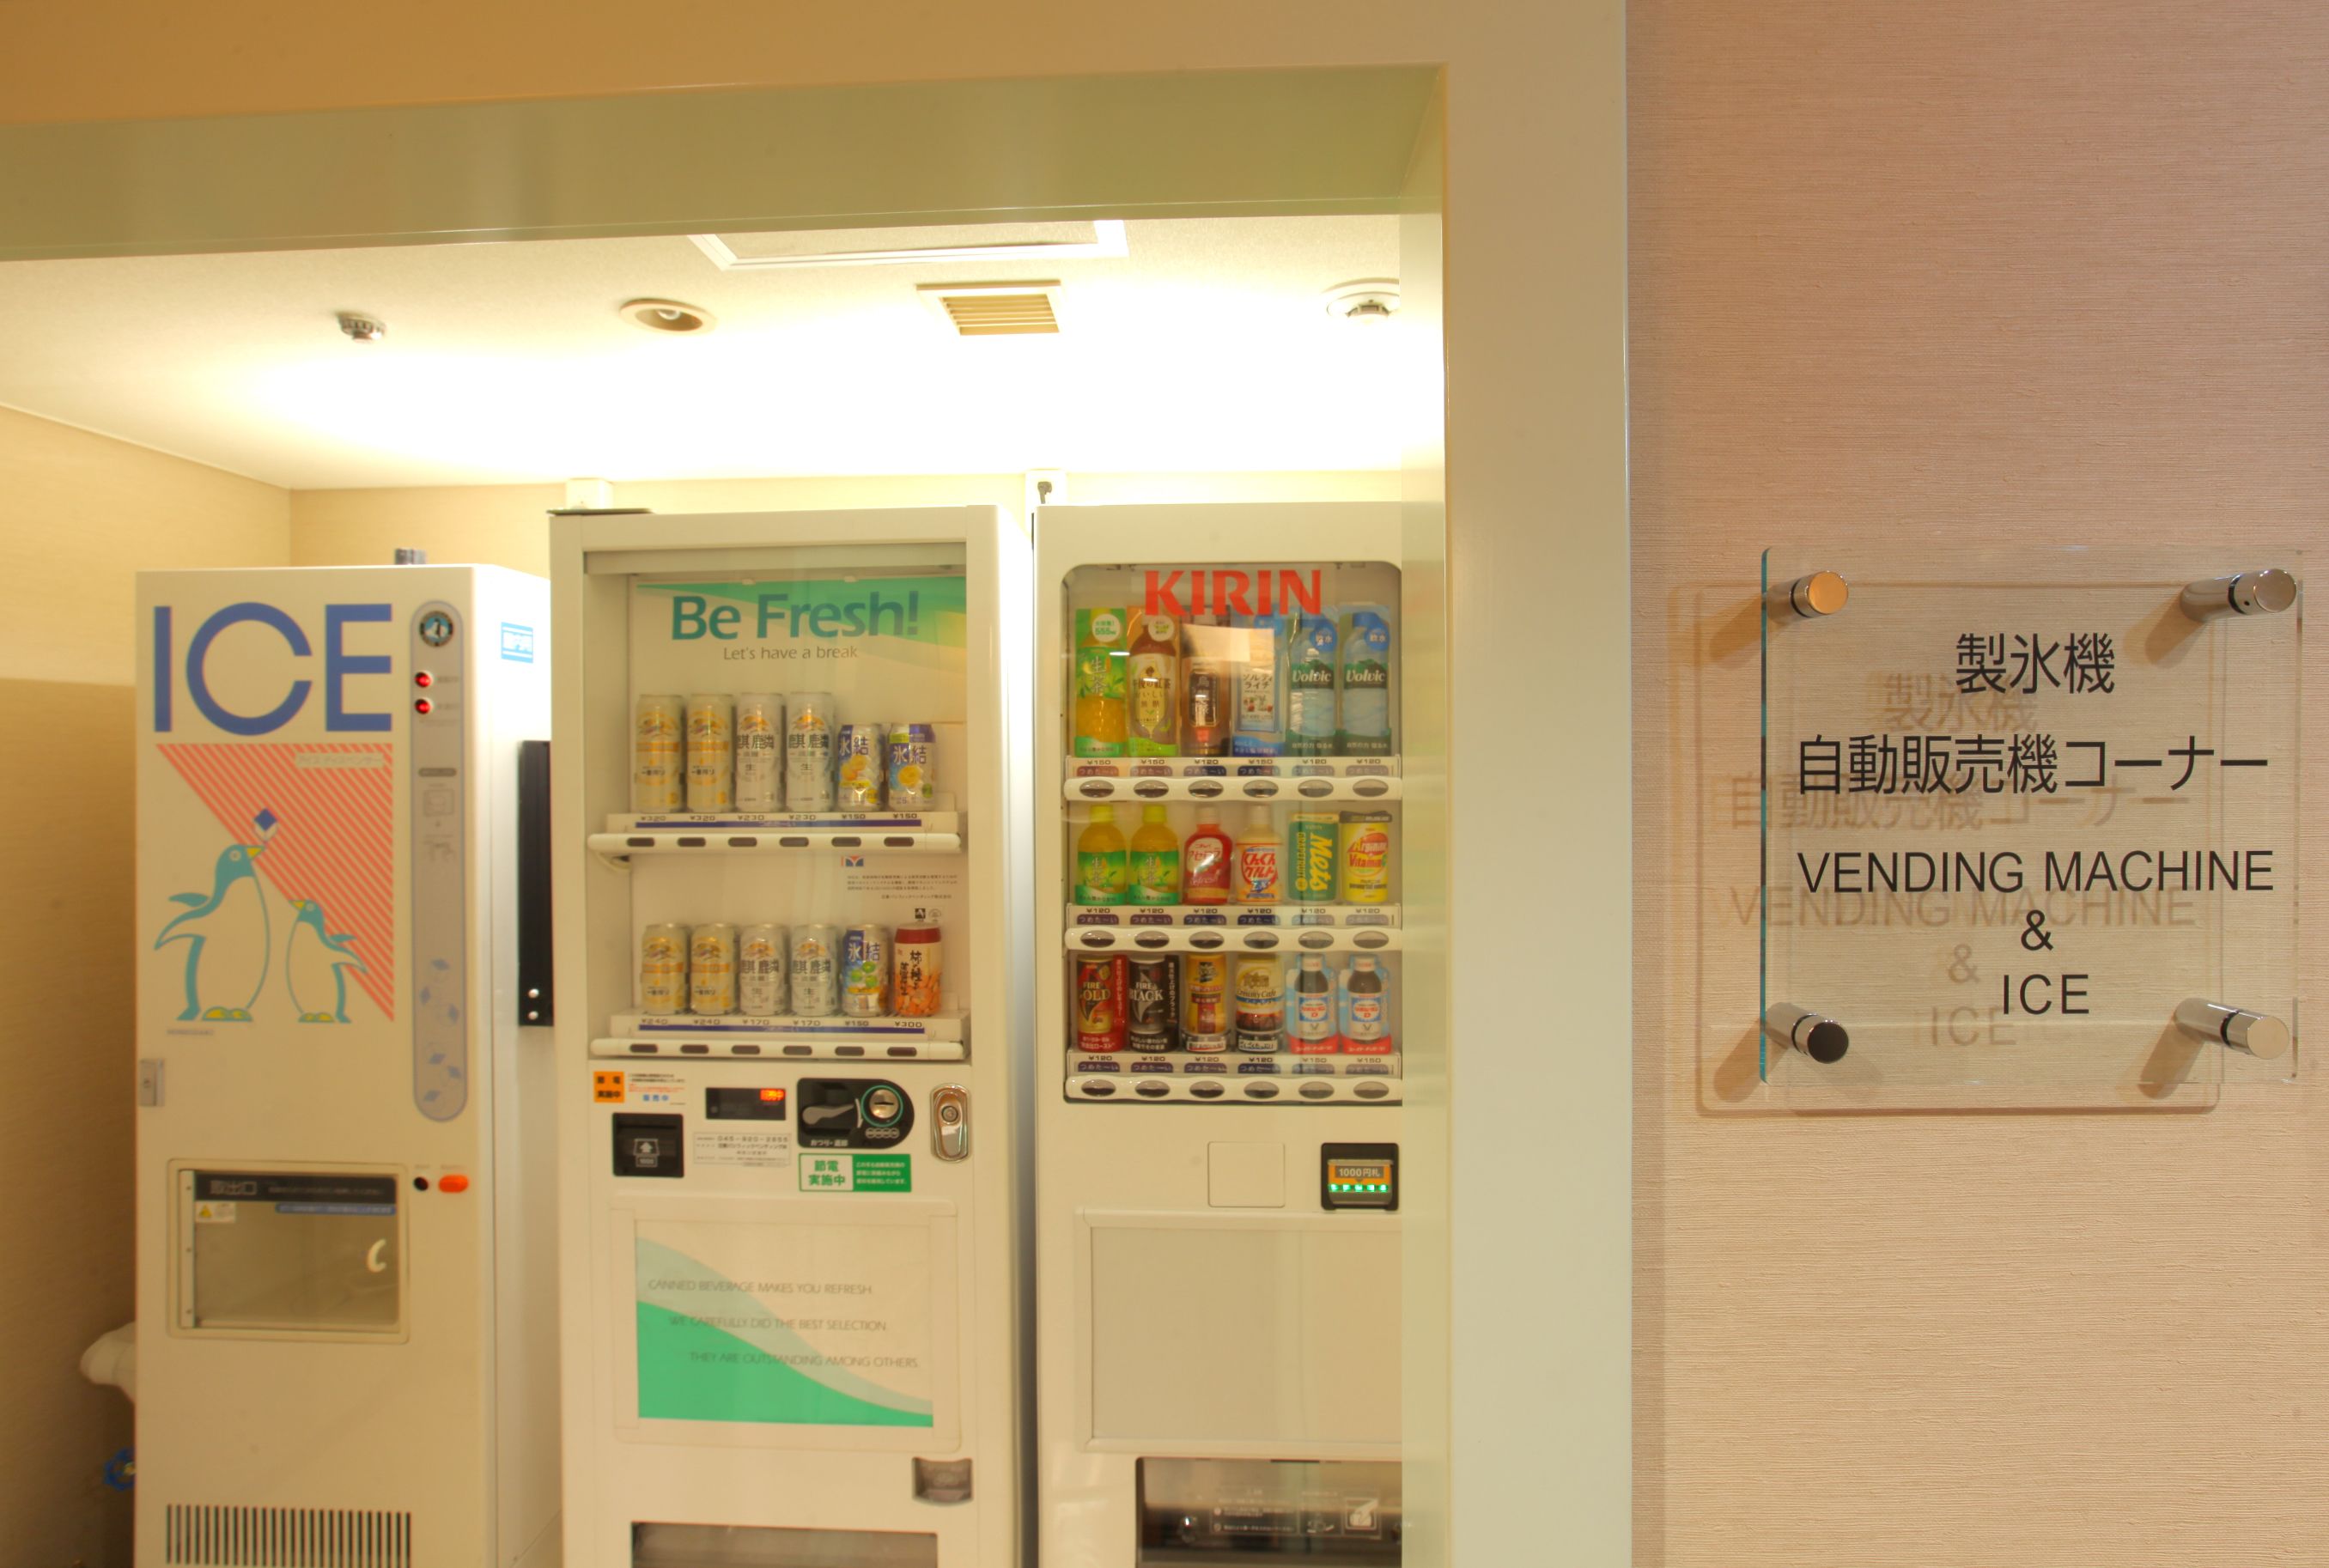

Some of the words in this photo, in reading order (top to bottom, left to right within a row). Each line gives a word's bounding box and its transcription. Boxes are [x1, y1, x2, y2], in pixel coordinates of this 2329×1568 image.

[1145, 570, 1321, 616] KIRIN
[672, 596, 741, 640] Be
[757, 591, 918, 638] Fresh!
[724, 647, 756, 660] Let's
[762, 646, 797, 659] have
[802, 648, 810, 659] a
[817, 646, 857, 659] break
[154, 602, 392, 735] ICE
[1955, 633, 2115, 694] 製氷機
[1292, 669, 1332, 683] Volvic
[1346, 669, 1386, 683] Volvic
[893, 745, 927, 764] 氷結
[1800, 734, 2269, 794] 自動販売機コーナー
[1310, 832, 1333, 891] Mets
[1797, 853, 2024, 892] VENDING
[2045, 851, 2274, 890] MACHINE
[2021, 911, 2053, 951] &
[848, 943, 880, 963] 氷結
[1129, 989, 1163, 1000] BLACK
[2003, 975, 2089, 1014] ICE
[814, 1160, 839, 1172] 節電
[1338, 1167, 1381, 1177] 1000円札
[809, 1175, 846, 1186] 実施中
[648, 1279, 696, 1291] CANNED
[698, 1280, 756, 1292] BEVERAGE
[757, 1282, 794, 1294] MAKES
[797, 1284, 821, 1294] YOU
[750, 1318, 770, 1328] DID
[775, 1318, 796, 1329] THE
[799, 1320, 824, 1330] BEST
[720, 1352, 739, 1362] ARE
[825, 1356, 870, 1367] AMONG
